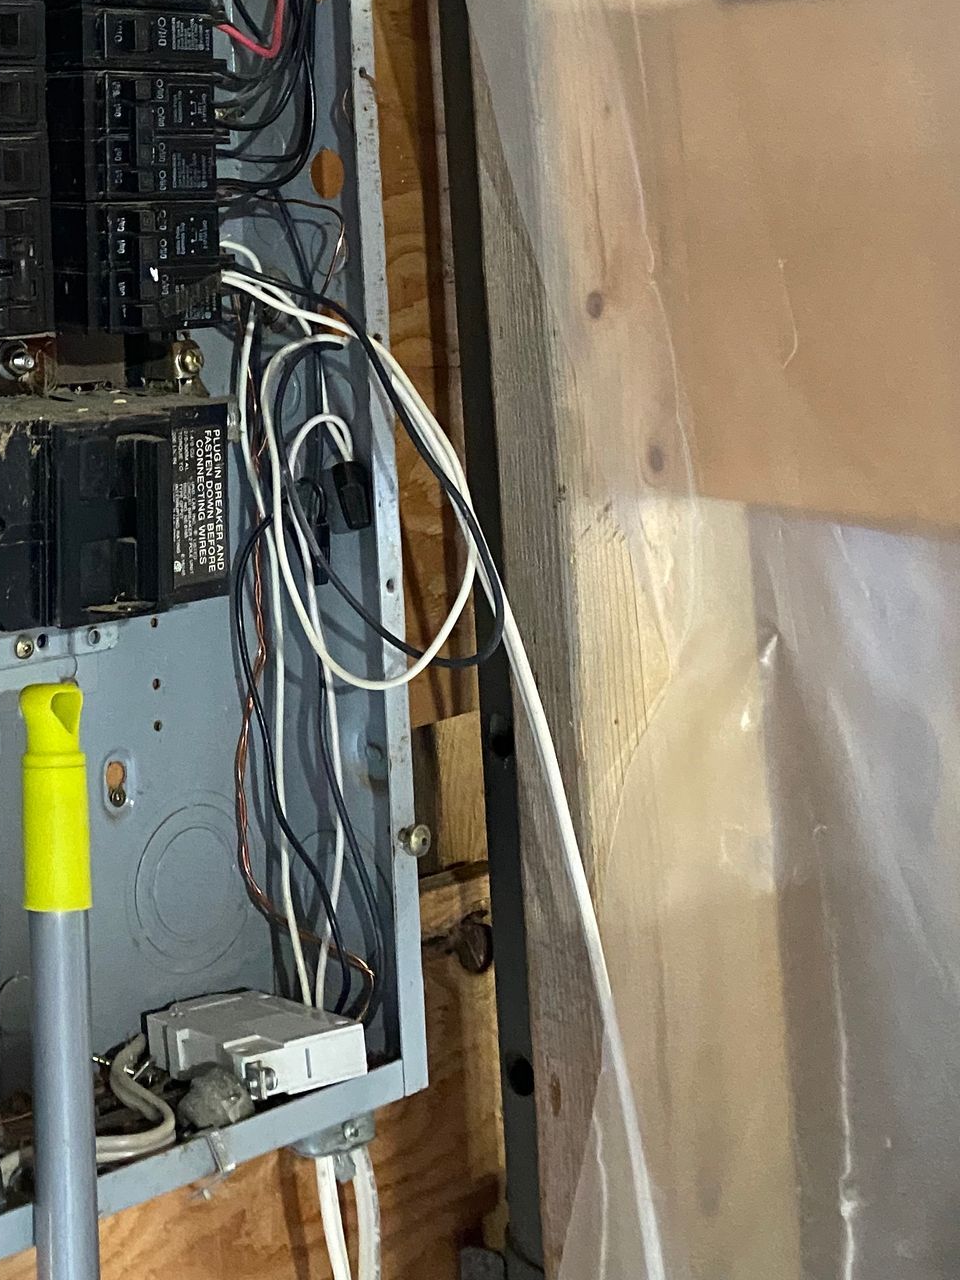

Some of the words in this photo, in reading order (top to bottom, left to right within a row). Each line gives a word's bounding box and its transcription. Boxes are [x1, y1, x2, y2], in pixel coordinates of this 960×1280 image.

[204, 429, 213, 477] FASTEN
[212, 428, 222, 462] PLUG
[195, 439, 206, 521] CONNECTING
[214, 465, 222, 479] IN
[205, 480, 214, 519] DOWN
[214, 483, 224, 541] BREAKER
[198, 524, 207, 565] WIRES
[206, 522, 216, 572] BEFORE
[216, 545, 225, 571] AND
